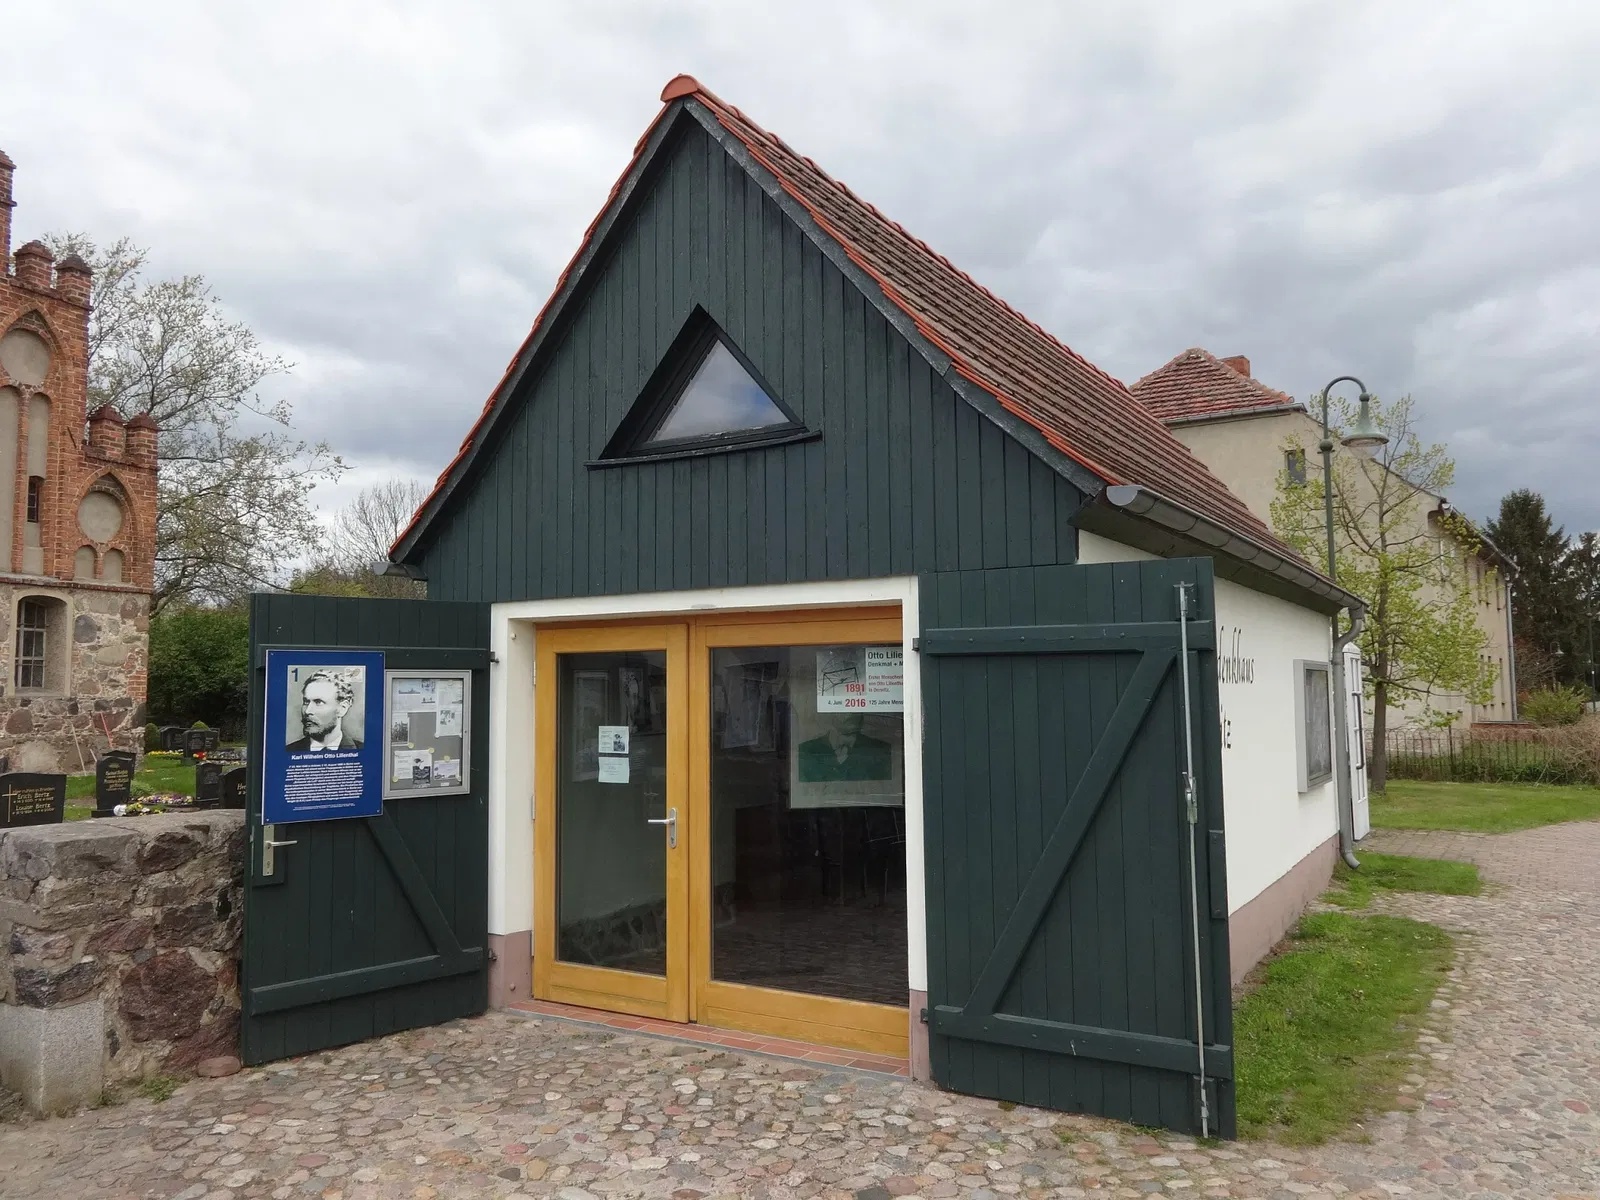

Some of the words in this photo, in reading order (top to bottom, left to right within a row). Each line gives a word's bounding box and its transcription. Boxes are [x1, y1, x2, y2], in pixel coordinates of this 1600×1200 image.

[868, 651, 884, 660] Otto
[886, 650, 903, 659] Lilie
[291, 668, 298, 682] 1
[845, 683, 865, 693] 1891
[845, 699, 866, 707] 2016
